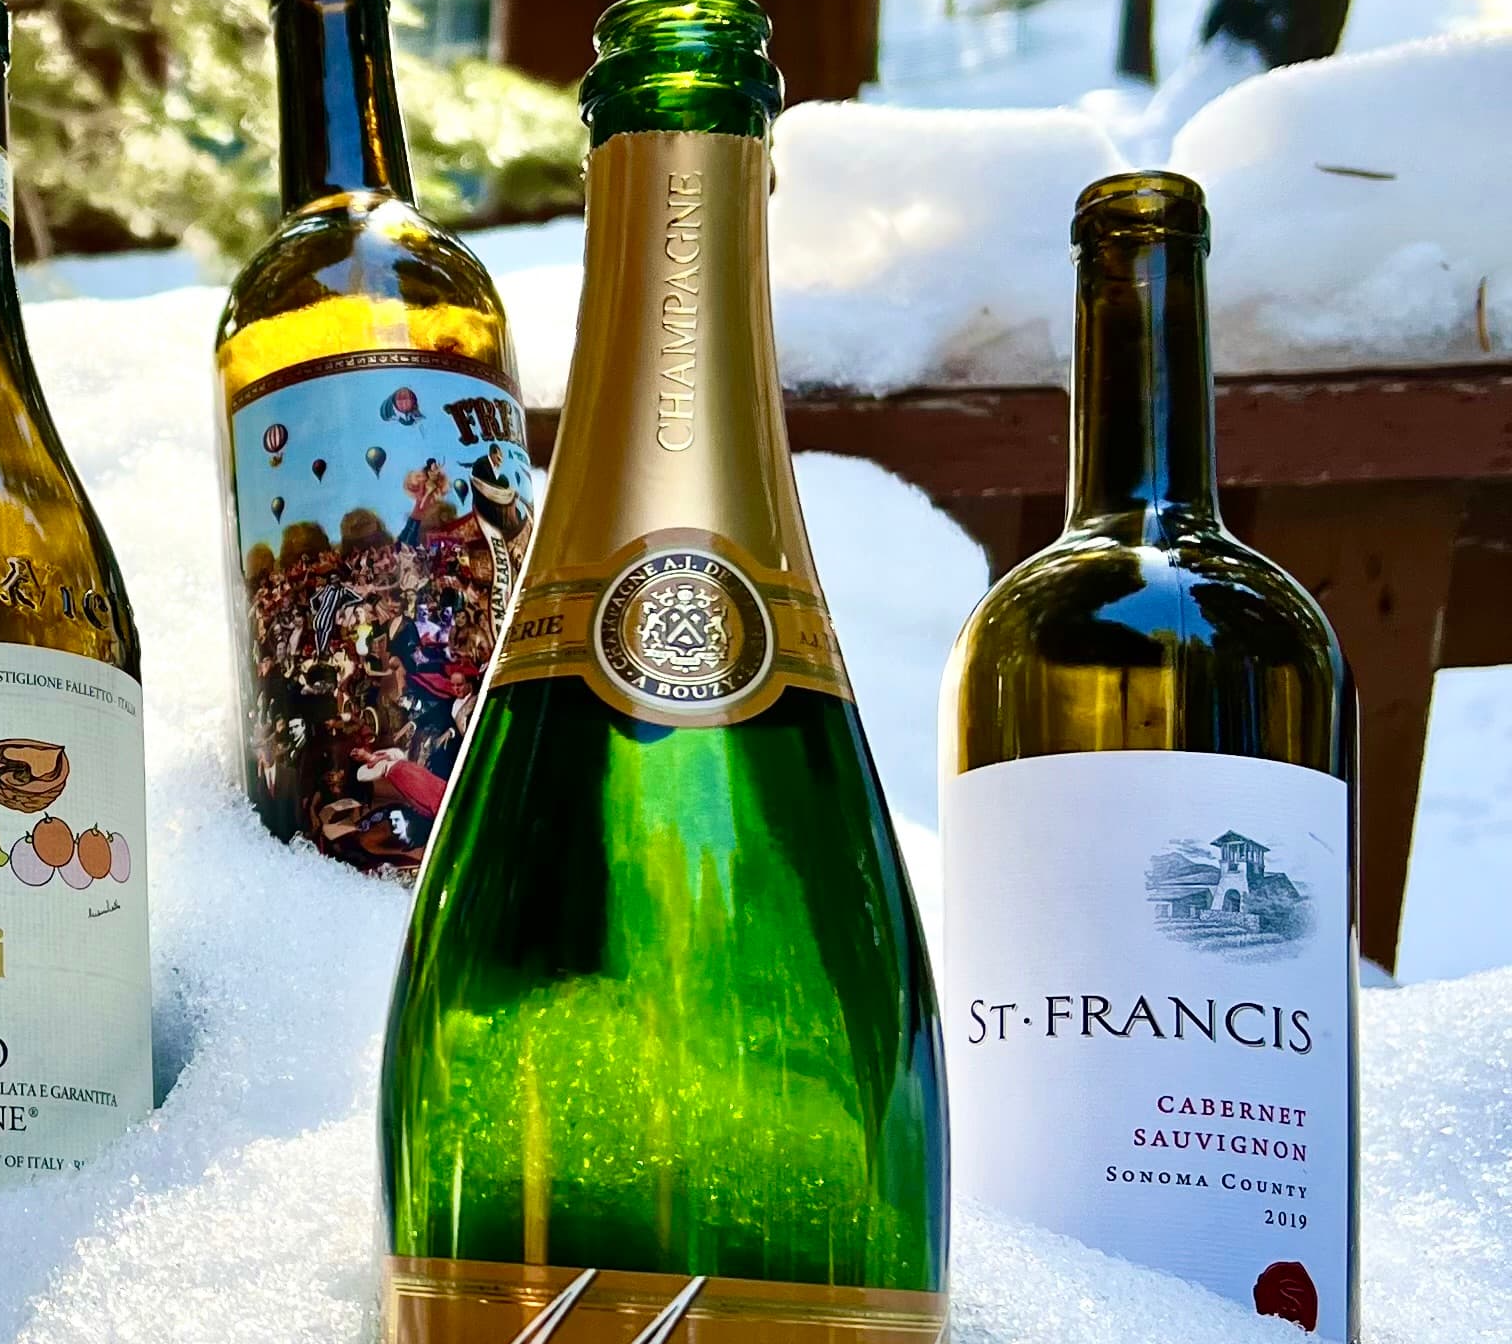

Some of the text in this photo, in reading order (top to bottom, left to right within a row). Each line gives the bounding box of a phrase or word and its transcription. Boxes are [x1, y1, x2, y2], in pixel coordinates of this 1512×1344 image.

[656, 170, 703, 453] CHAMPAGNE
[490, 535, 511, 586] EARTH
[603, 564, 658, 672] CHAMPAGNE
[65, 679, 114, 705] FALLETTO
[656, 677, 736, 700] BOUZY
[1044, 994, 1314, 1055] FRANCIS
[40, 1084, 49, 1098] E
[50, 1084, 118, 1108] GARANTITA
[1157, 1095, 1307, 1128] CABERNET
[1133, 1128, 1307, 1162] SAUVIGNON
[4, 1154, 24, 1168] OF
[27, 1155, 65, 1171] ITALY
[1106, 1166, 1308, 1199] SONOMA COUNTY
[1264, 1209, 1308, 1230] 2019
